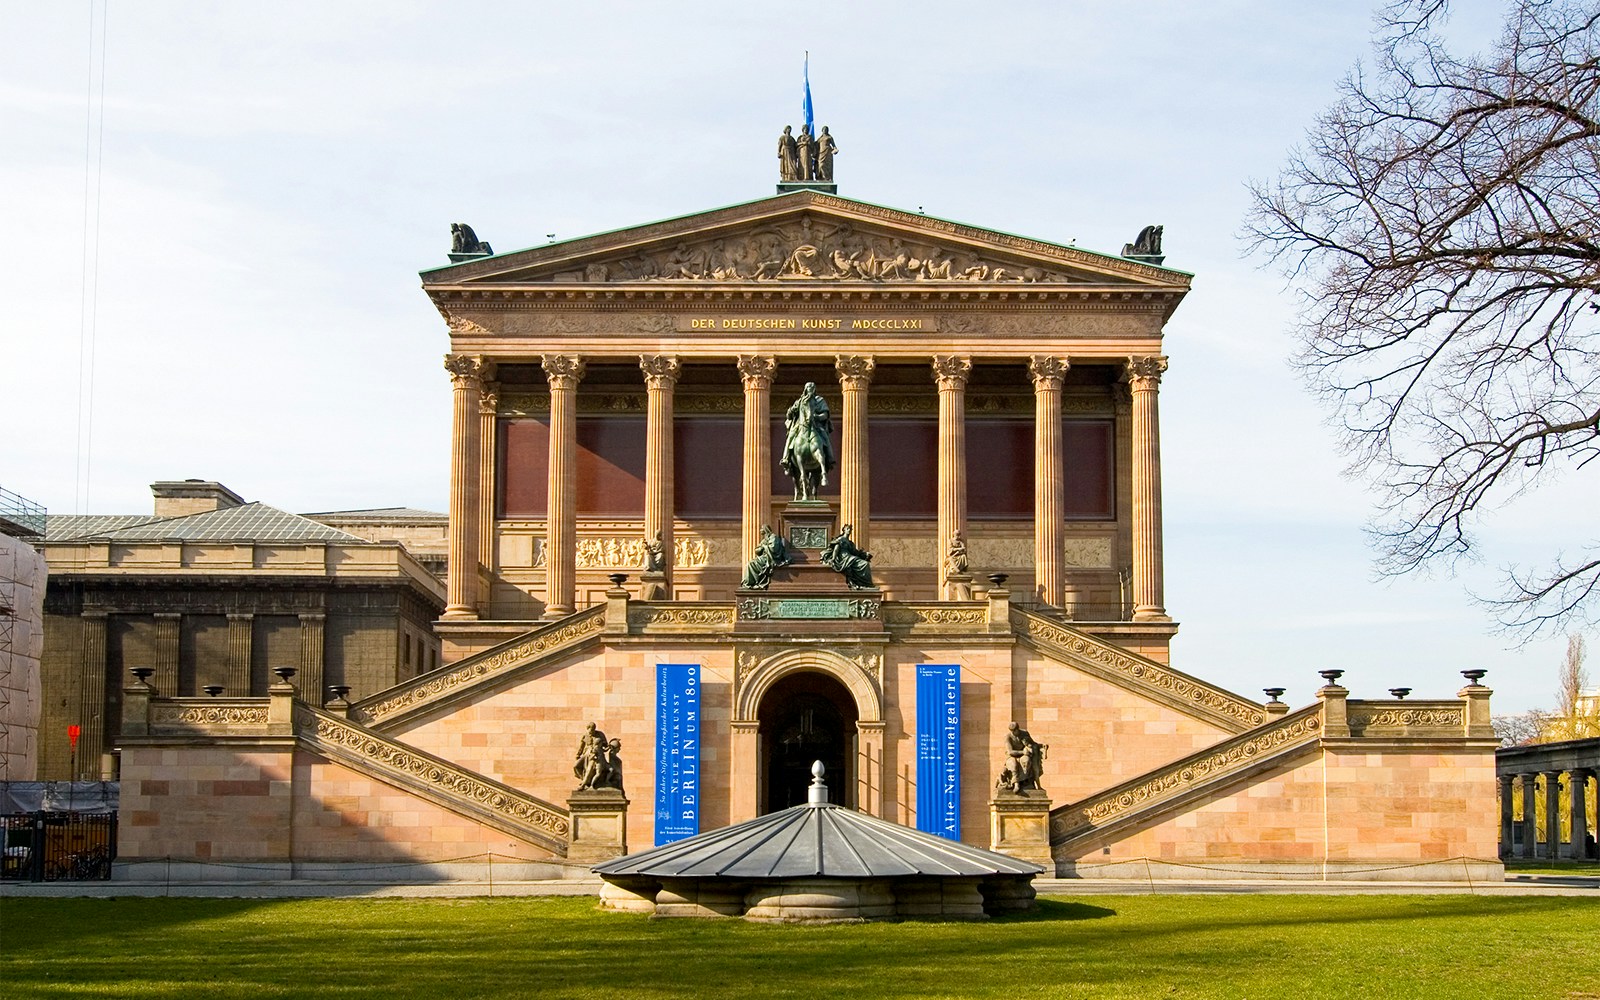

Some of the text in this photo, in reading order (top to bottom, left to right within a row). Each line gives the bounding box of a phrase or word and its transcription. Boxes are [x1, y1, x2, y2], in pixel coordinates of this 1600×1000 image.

[691, 319, 922, 329] DER DEUTSCHEN KUNST MDCCCLXXI
[660, 667, 668, 707] Kulturbesitz
[660, 747, 668, 775] Stiftung
[671, 693, 679, 794] NEUE BAUKUNST
[683, 668, 696, 820] BERLIN UM 1800
[944, 668, 958, 832] Alte Nationalgalerie
